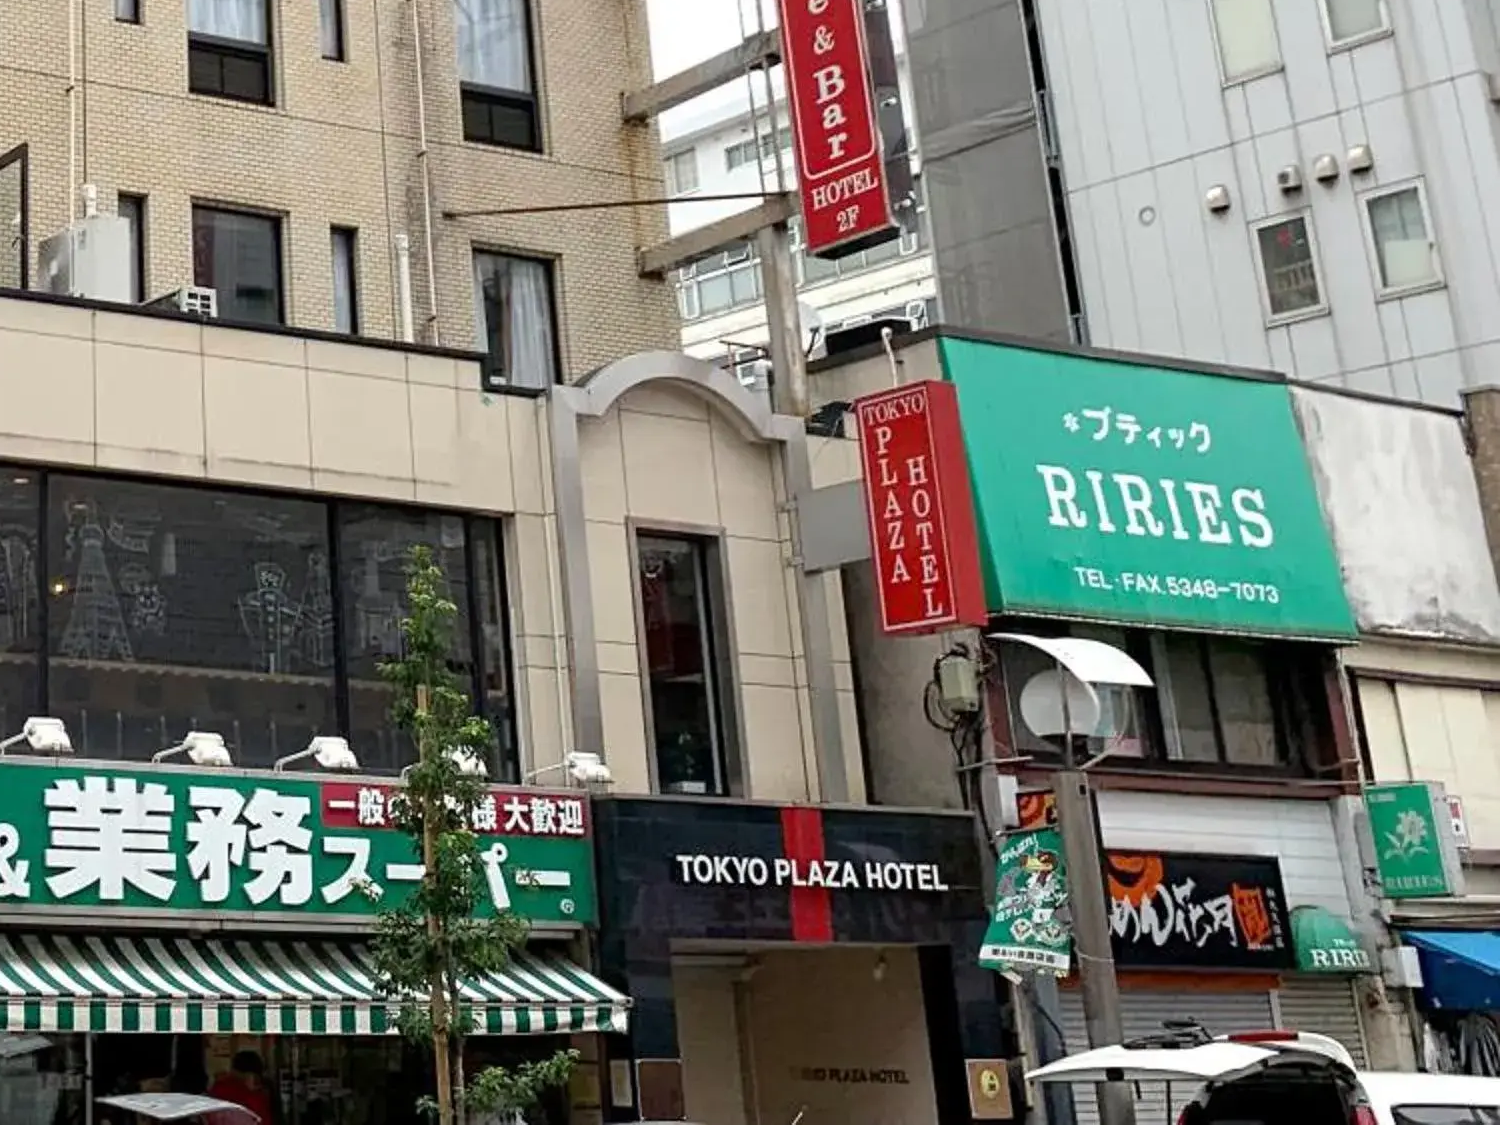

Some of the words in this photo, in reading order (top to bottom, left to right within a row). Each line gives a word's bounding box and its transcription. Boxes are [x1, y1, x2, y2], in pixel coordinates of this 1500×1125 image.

[812, 26, 836, 57] &
[812, 65, 848, 161] Bar
[811, 169, 881, 211] HOTEL
[836, 204, 860, 234] 2F
[862, 390, 925, 425] TOKYO
[874, 427, 911, 583] PLAZA
[1036, 463, 1274, 549] RIRIES
[906, 458, 944, 617] HOTEL
[676, 854, 768, 886] TOKYO
[774, 858, 860, 889] PLAZA
[865, 862, 949, 892] HOTEL
